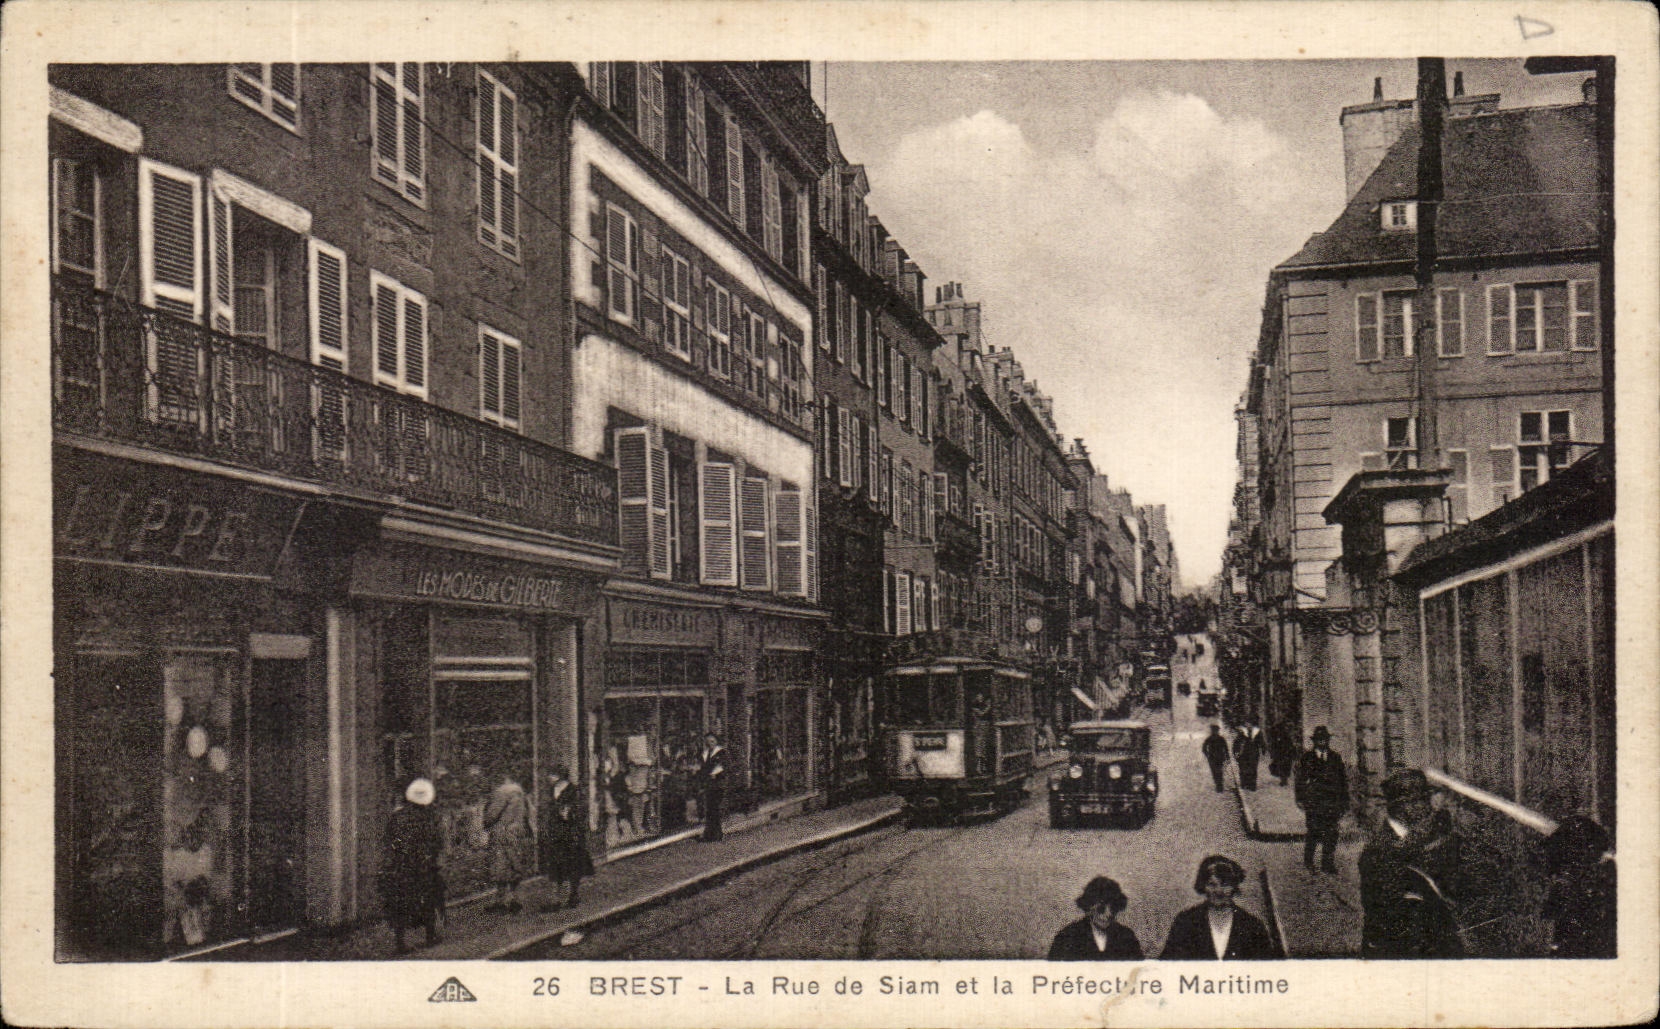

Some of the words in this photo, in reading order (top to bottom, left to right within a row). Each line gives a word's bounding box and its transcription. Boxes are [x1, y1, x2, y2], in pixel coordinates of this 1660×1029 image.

[416, 570, 437, 596] LES
[438, 570, 487, 601] MODES
[500, 574, 563, 608] GILBERTE
